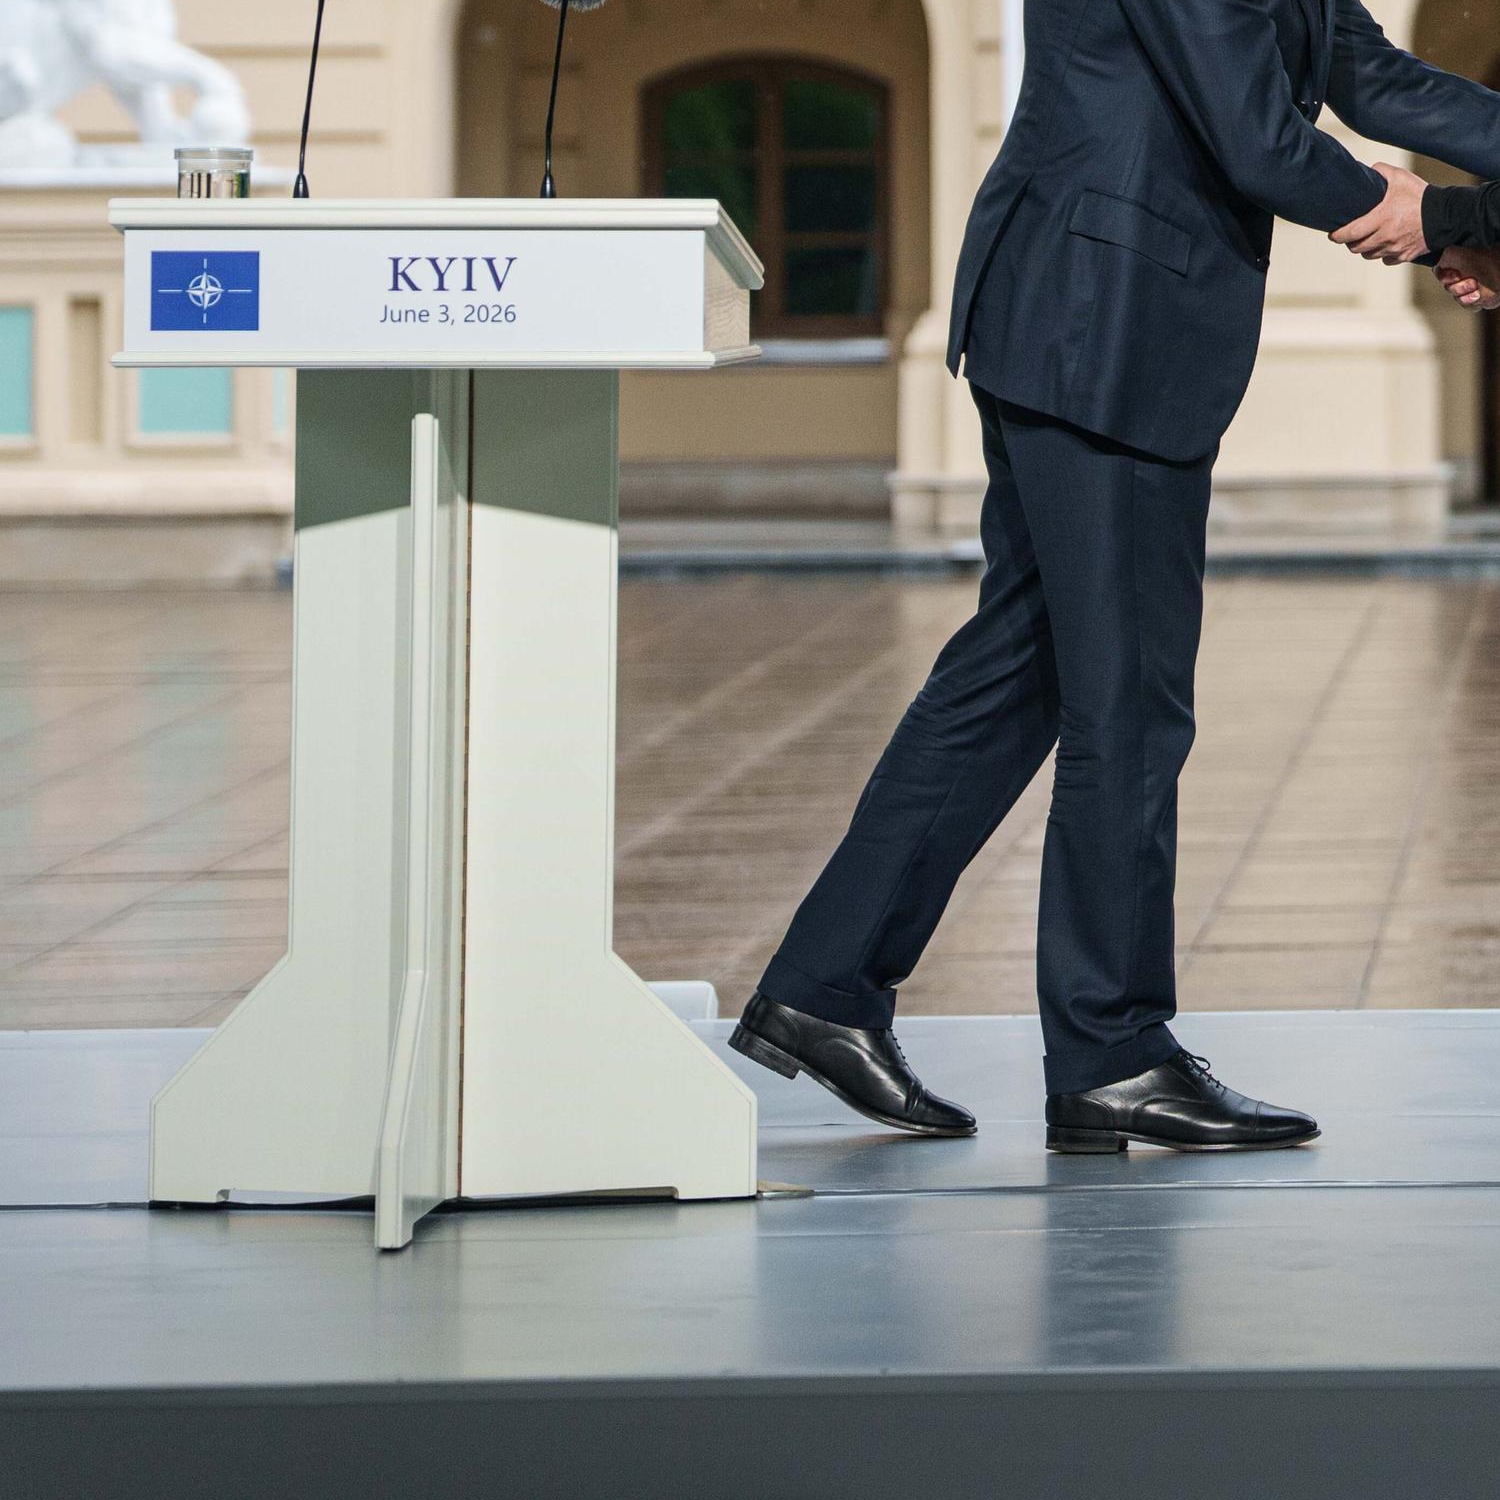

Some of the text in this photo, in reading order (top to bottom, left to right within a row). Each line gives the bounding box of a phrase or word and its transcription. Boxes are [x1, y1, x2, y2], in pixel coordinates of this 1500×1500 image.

[388, 256, 518, 292] KYIV
[379, 304, 517, 327] June 3, 2026
